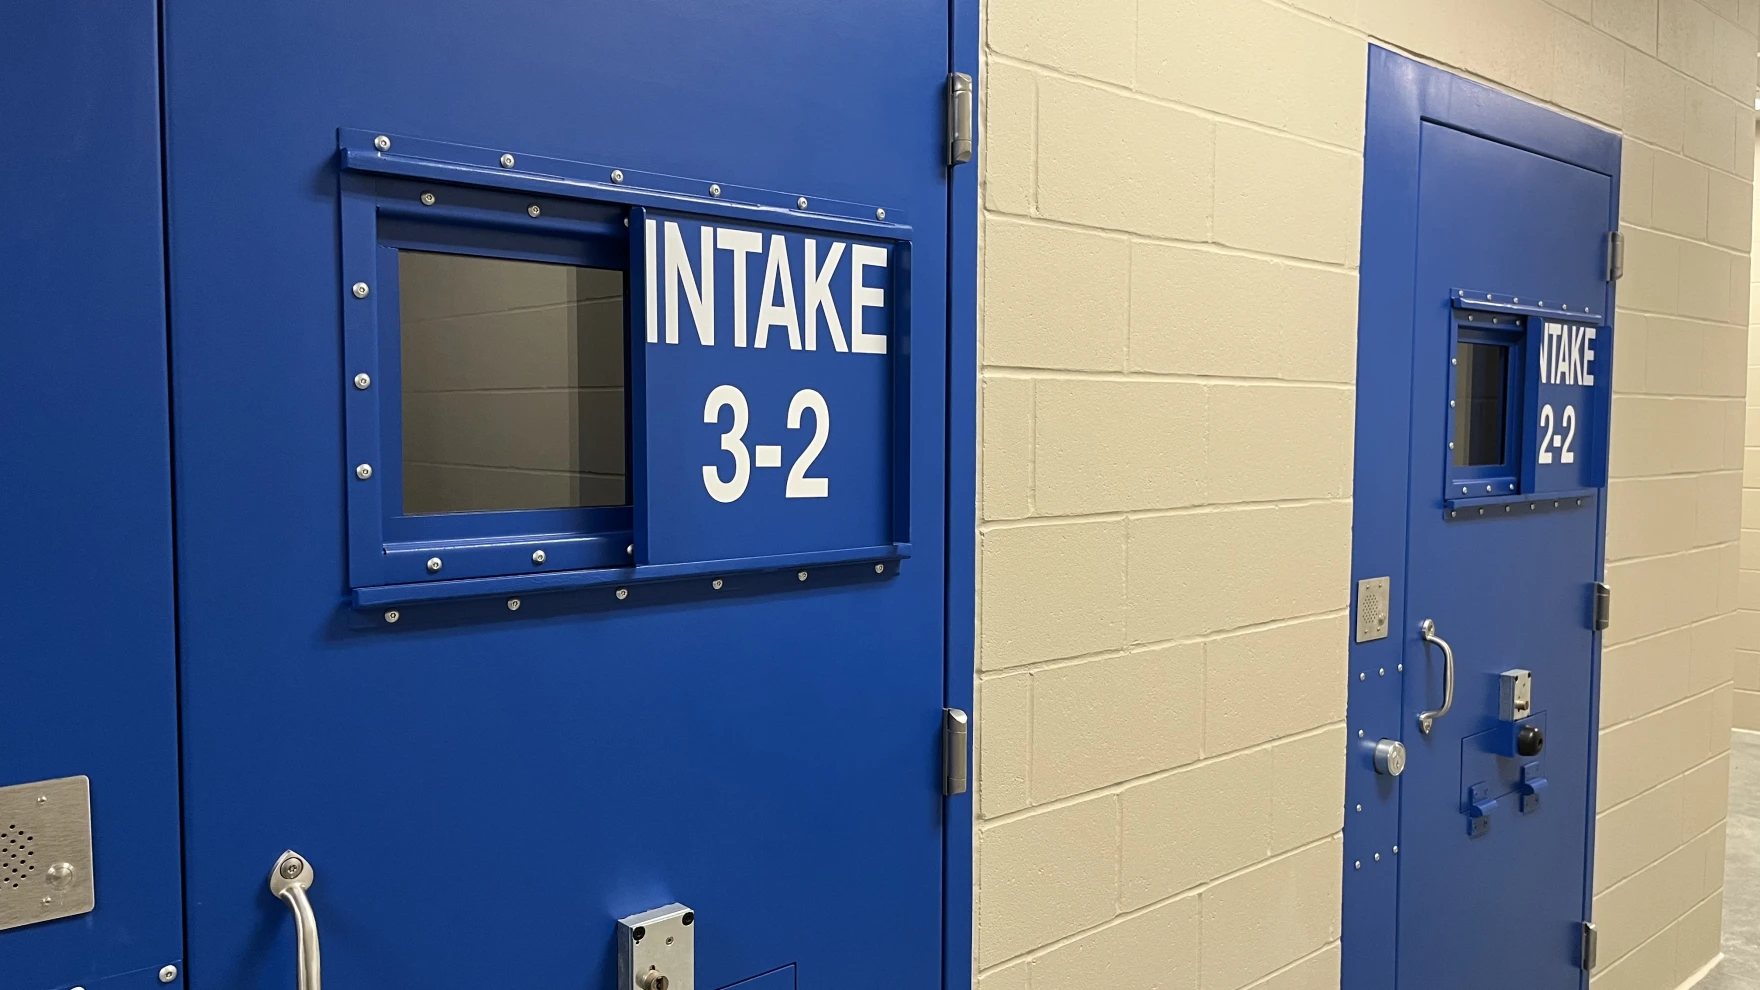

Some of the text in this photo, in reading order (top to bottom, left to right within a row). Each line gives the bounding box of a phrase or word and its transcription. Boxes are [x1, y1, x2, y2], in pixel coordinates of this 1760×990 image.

[645, 219, 888, 354] INTAKE
[1539, 322, 1597, 386] NTAKE
[702, 385, 830, 503] 3-2
[1538, 403, 1576, 464] 2-2
